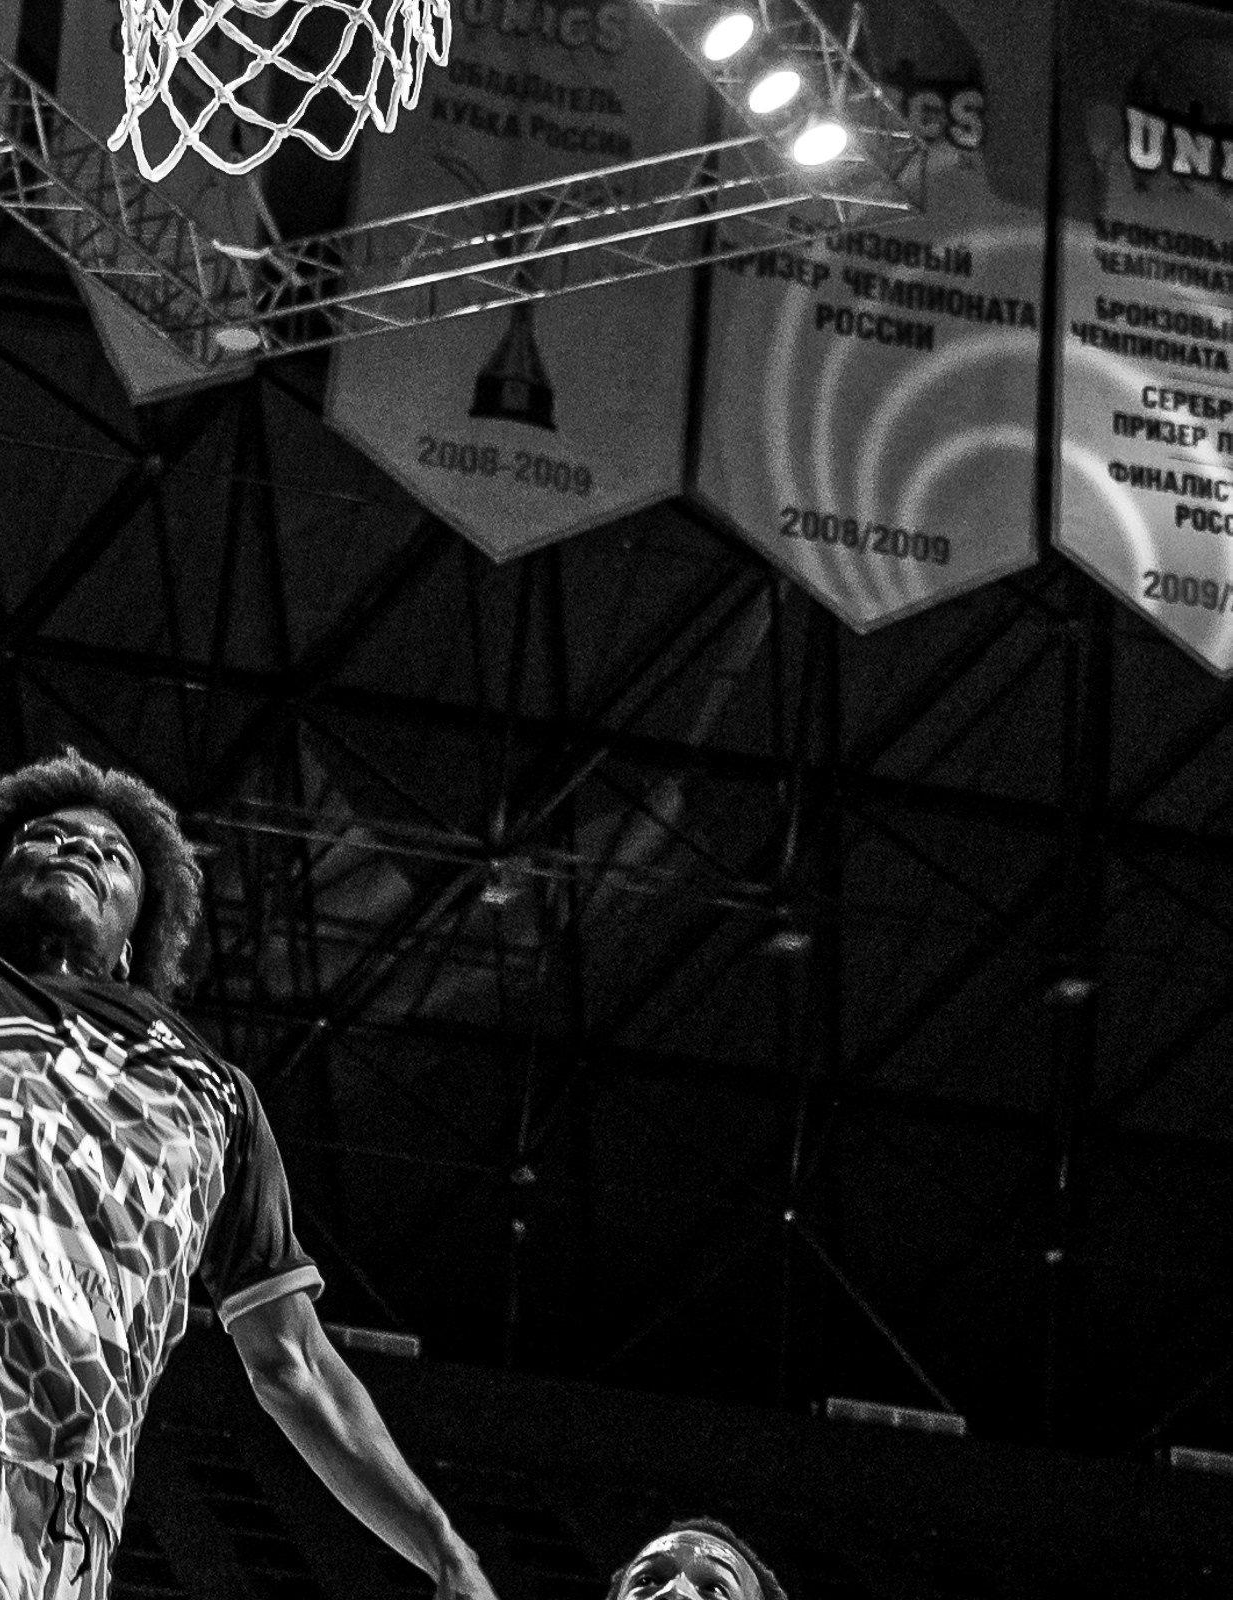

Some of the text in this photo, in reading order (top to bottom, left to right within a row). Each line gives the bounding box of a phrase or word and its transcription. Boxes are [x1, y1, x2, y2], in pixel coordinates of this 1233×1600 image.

[844, 266, 1038, 330] ЧЕМПИОНАТА
[817, 303, 934, 351] РОССИИ
[1071, 321, 1230, 372] ЧЕМПИОНАТА
[1113, 410, 1208, 447] ПРИЗЕР
[416, 435, 593, 498] 2008-2009
[780, 506, 952, 566] 2008/2009
[1143, 570, 1233, 614] 2009/
